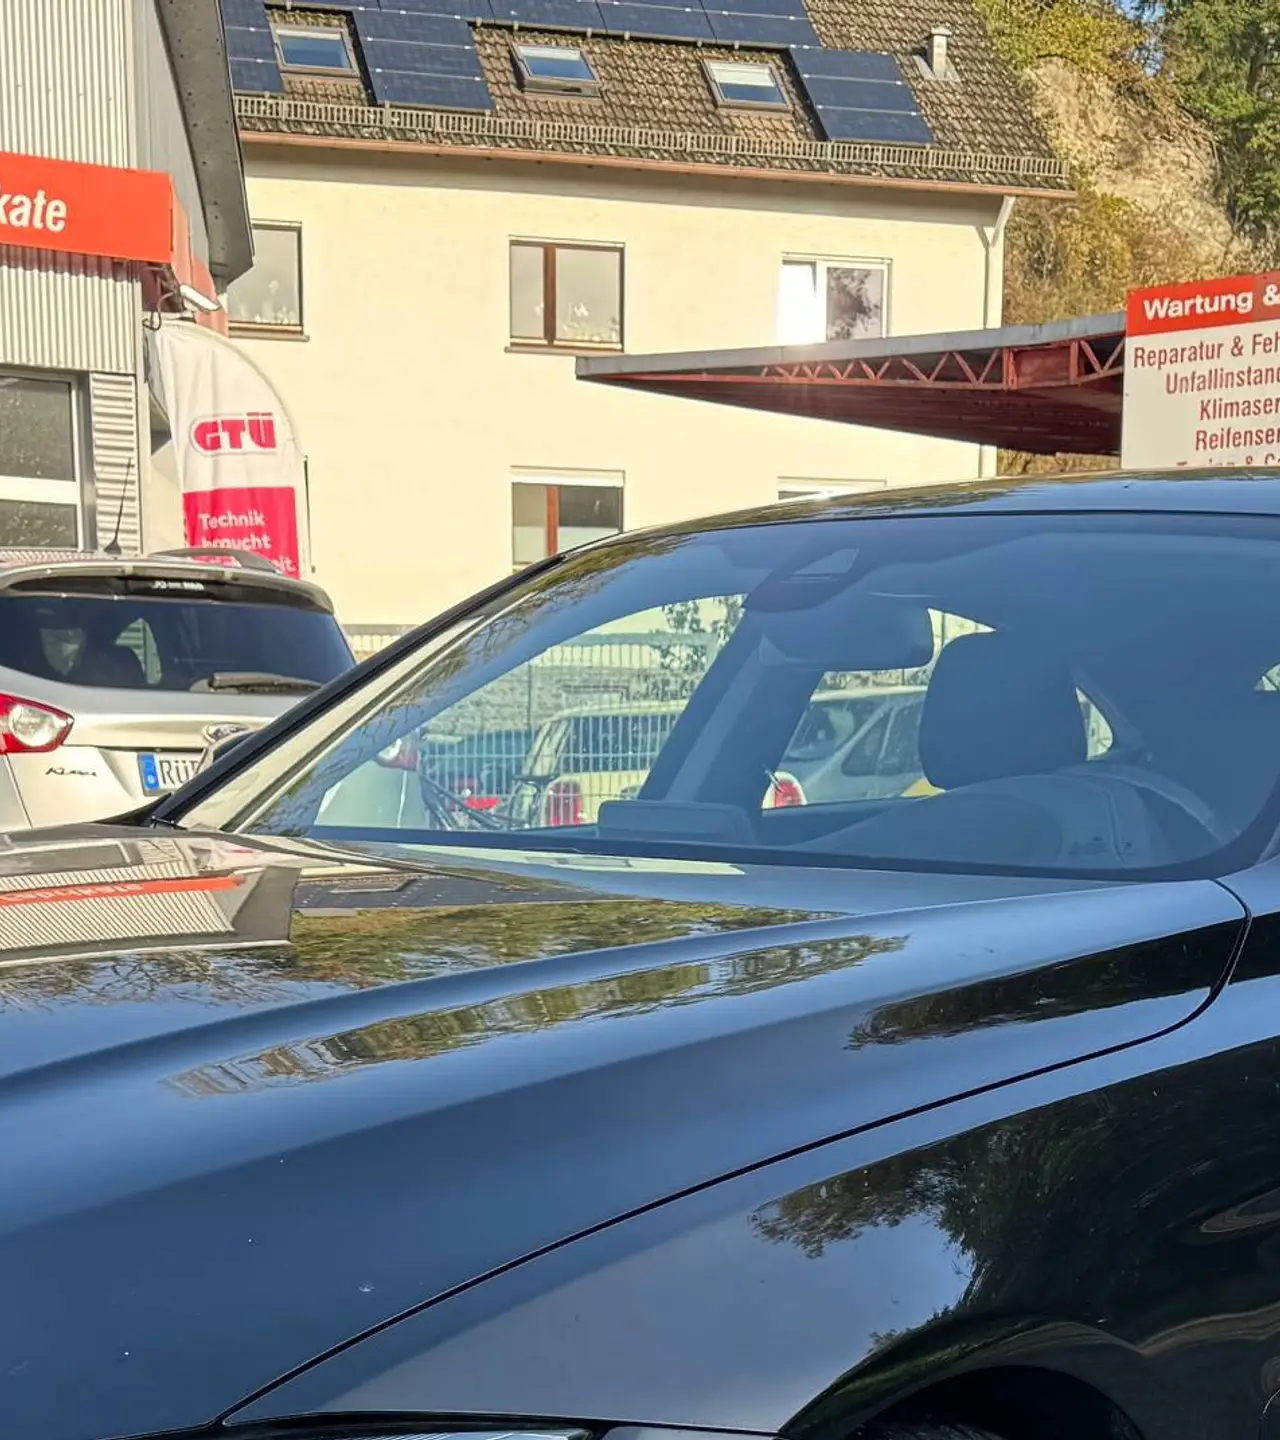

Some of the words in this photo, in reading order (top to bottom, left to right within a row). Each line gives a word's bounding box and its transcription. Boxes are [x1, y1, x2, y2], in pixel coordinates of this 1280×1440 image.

[1143, 290, 1254, 321] Wartung
[1133, 340, 1224, 369] Reparatur
[1230, 336, 1245, 356] &
[193, 411, 277, 453] GTÜ
[198, 509, 266, 531] Technik
